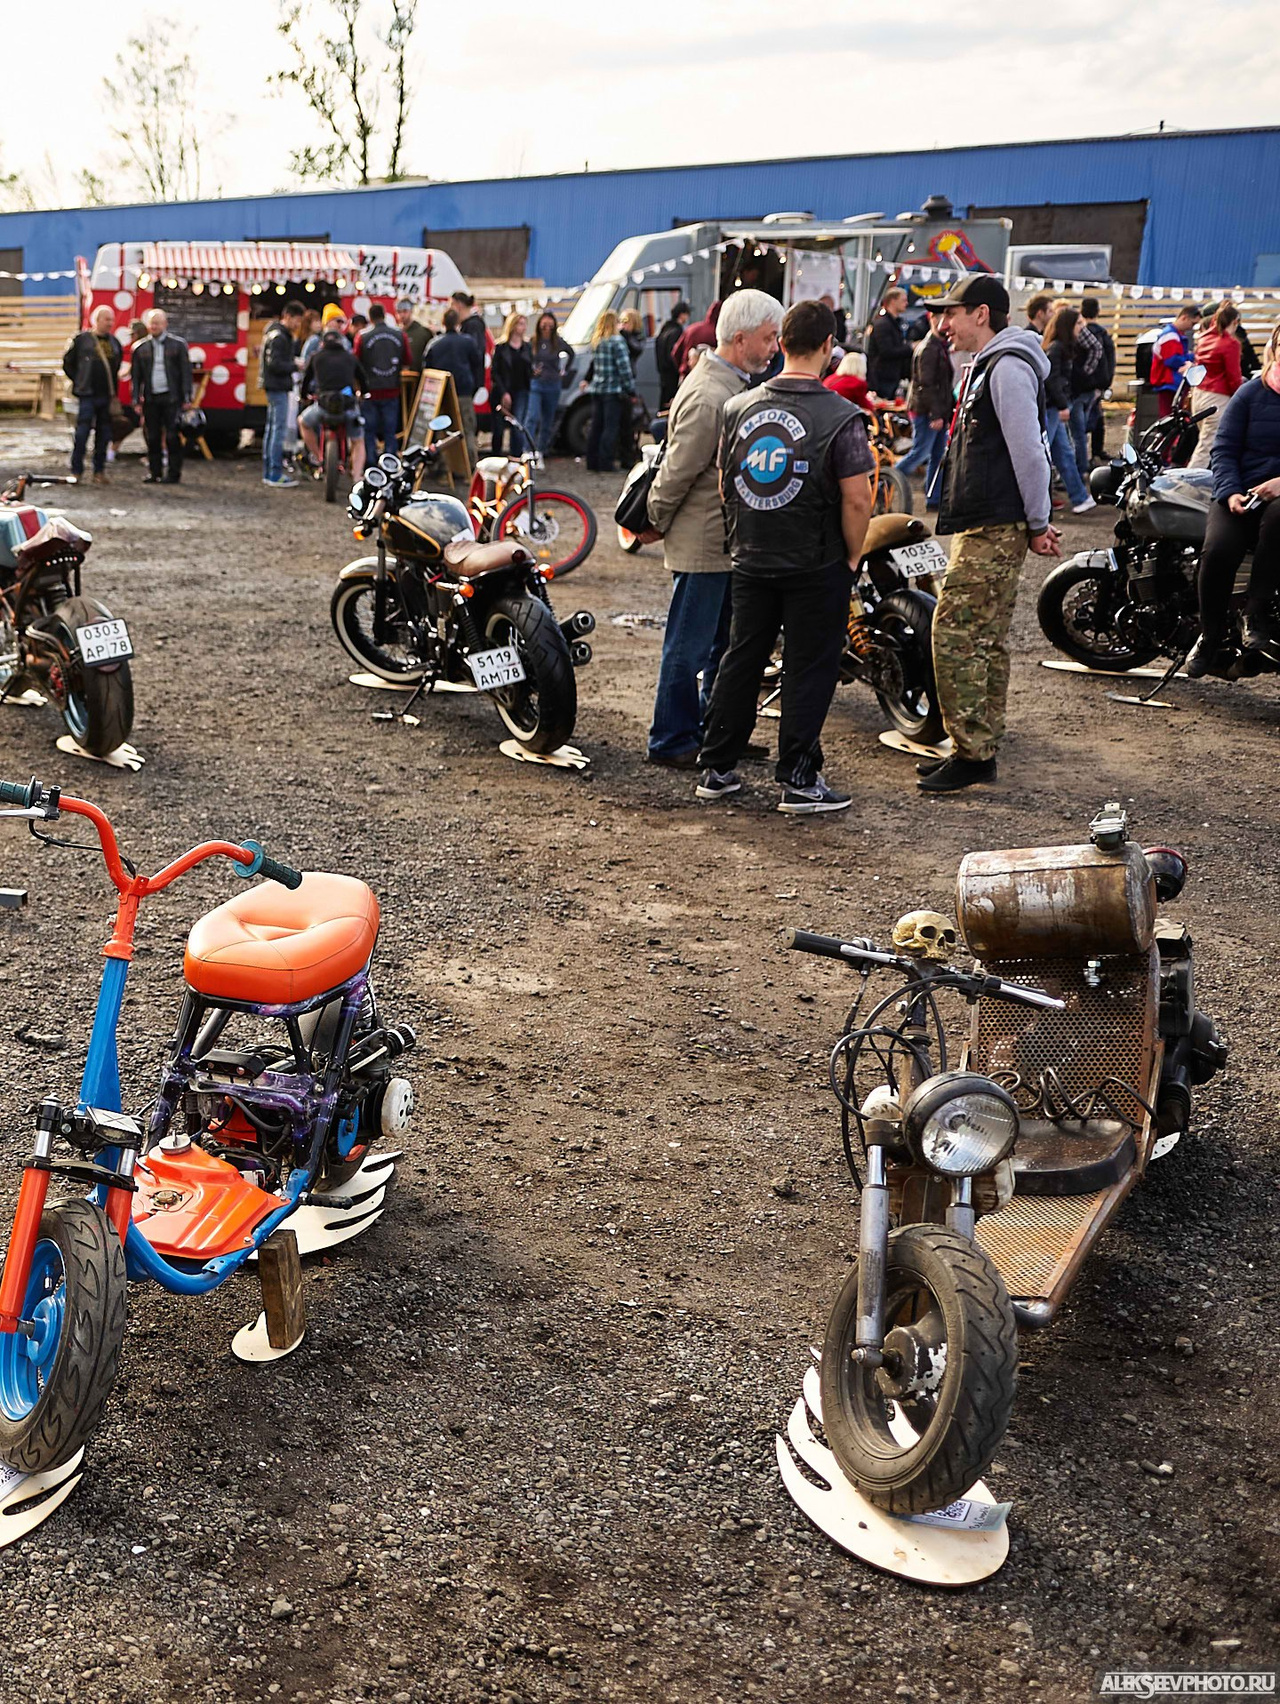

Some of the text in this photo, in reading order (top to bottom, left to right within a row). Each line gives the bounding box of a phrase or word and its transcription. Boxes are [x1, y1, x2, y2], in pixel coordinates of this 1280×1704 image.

[743, 411, 803, 437] M-FORCE
[745, 447, 788, 472] MF
[901, 543, 935, 558] 1035
[928, 557, 948, 569] 78
[84, 623, 120, 640] 0303
[110, 640, 128, 654] 78
[477, 651, 511, 668] 5119
[503, 667, 520, 680] 78
